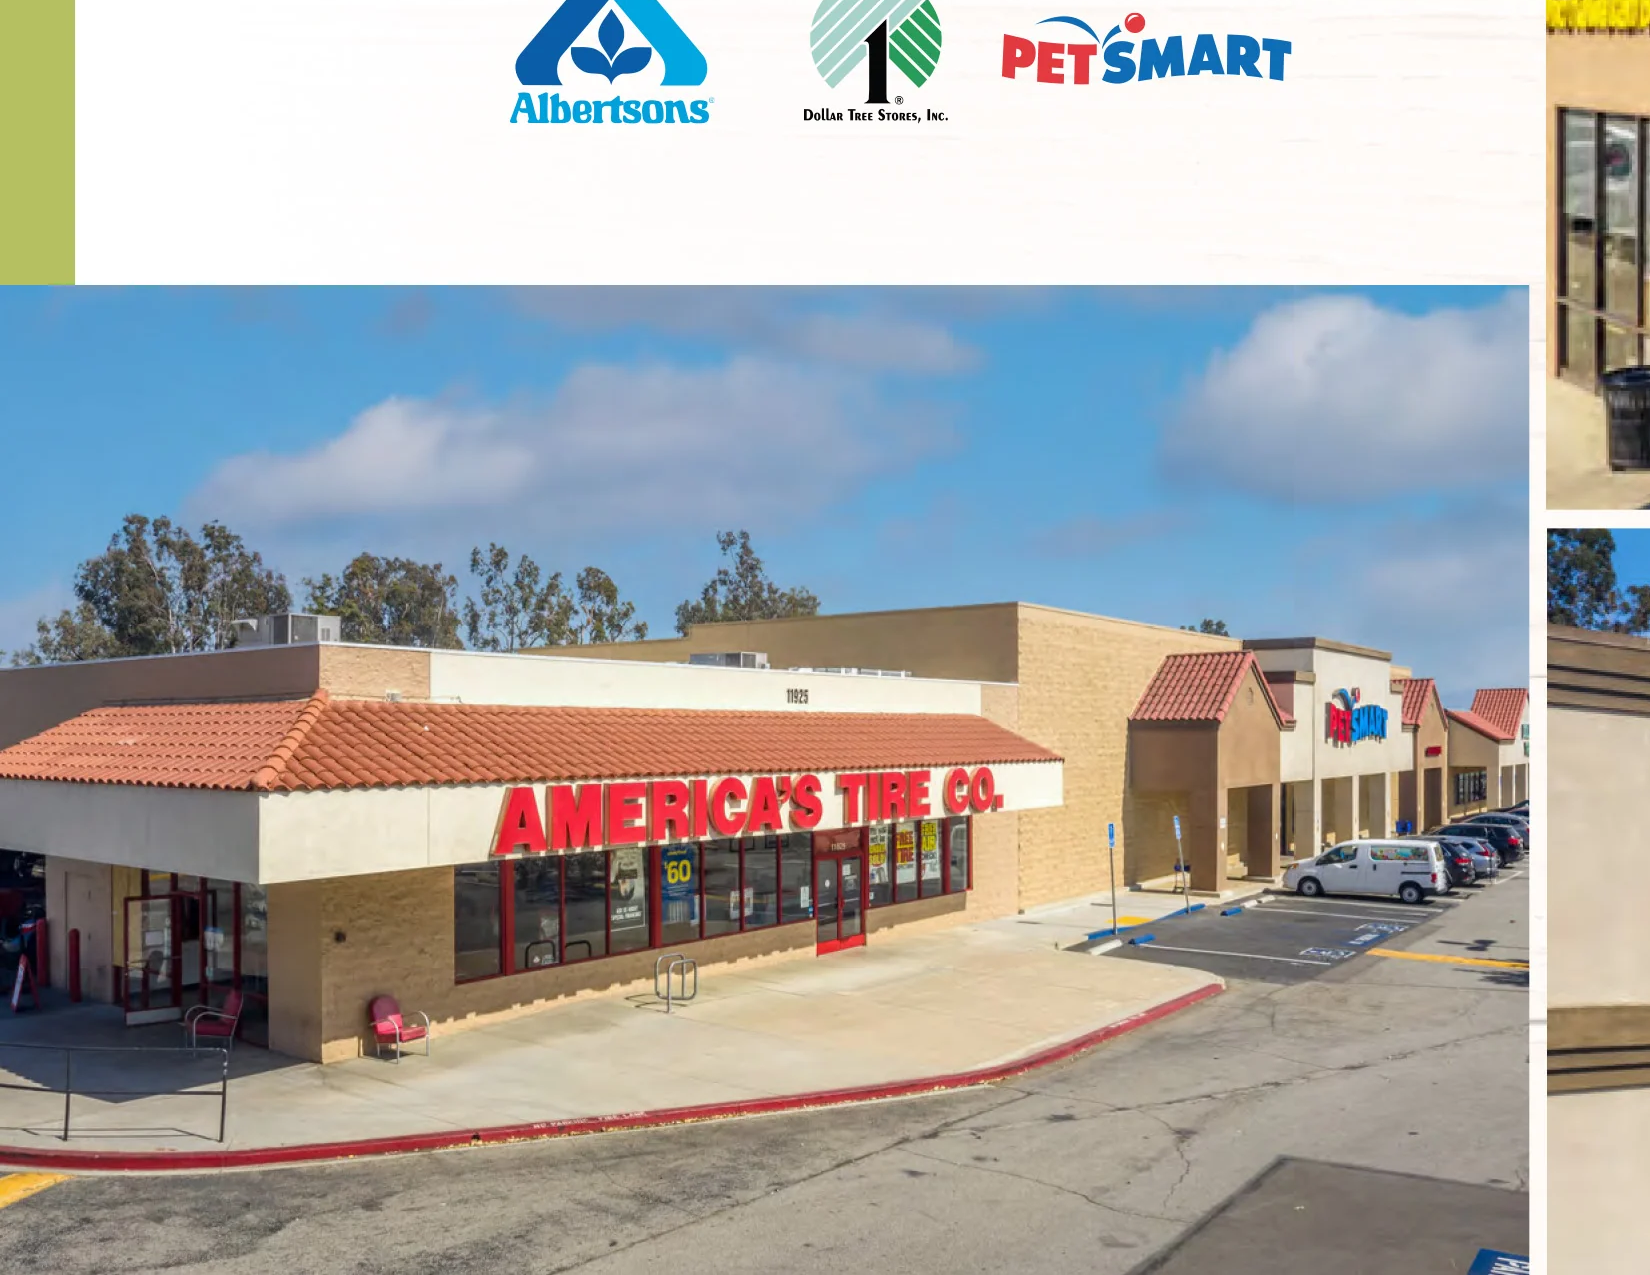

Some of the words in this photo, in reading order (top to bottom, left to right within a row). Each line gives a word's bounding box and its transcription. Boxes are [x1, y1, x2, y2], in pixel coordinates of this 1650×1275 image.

[786, 688, 809, 704] 11925
[490, 773, 823, 855] AMERICA'S
[838, 769, 931, 824] TIRE
[945, 766, 1004, 814] CO.
